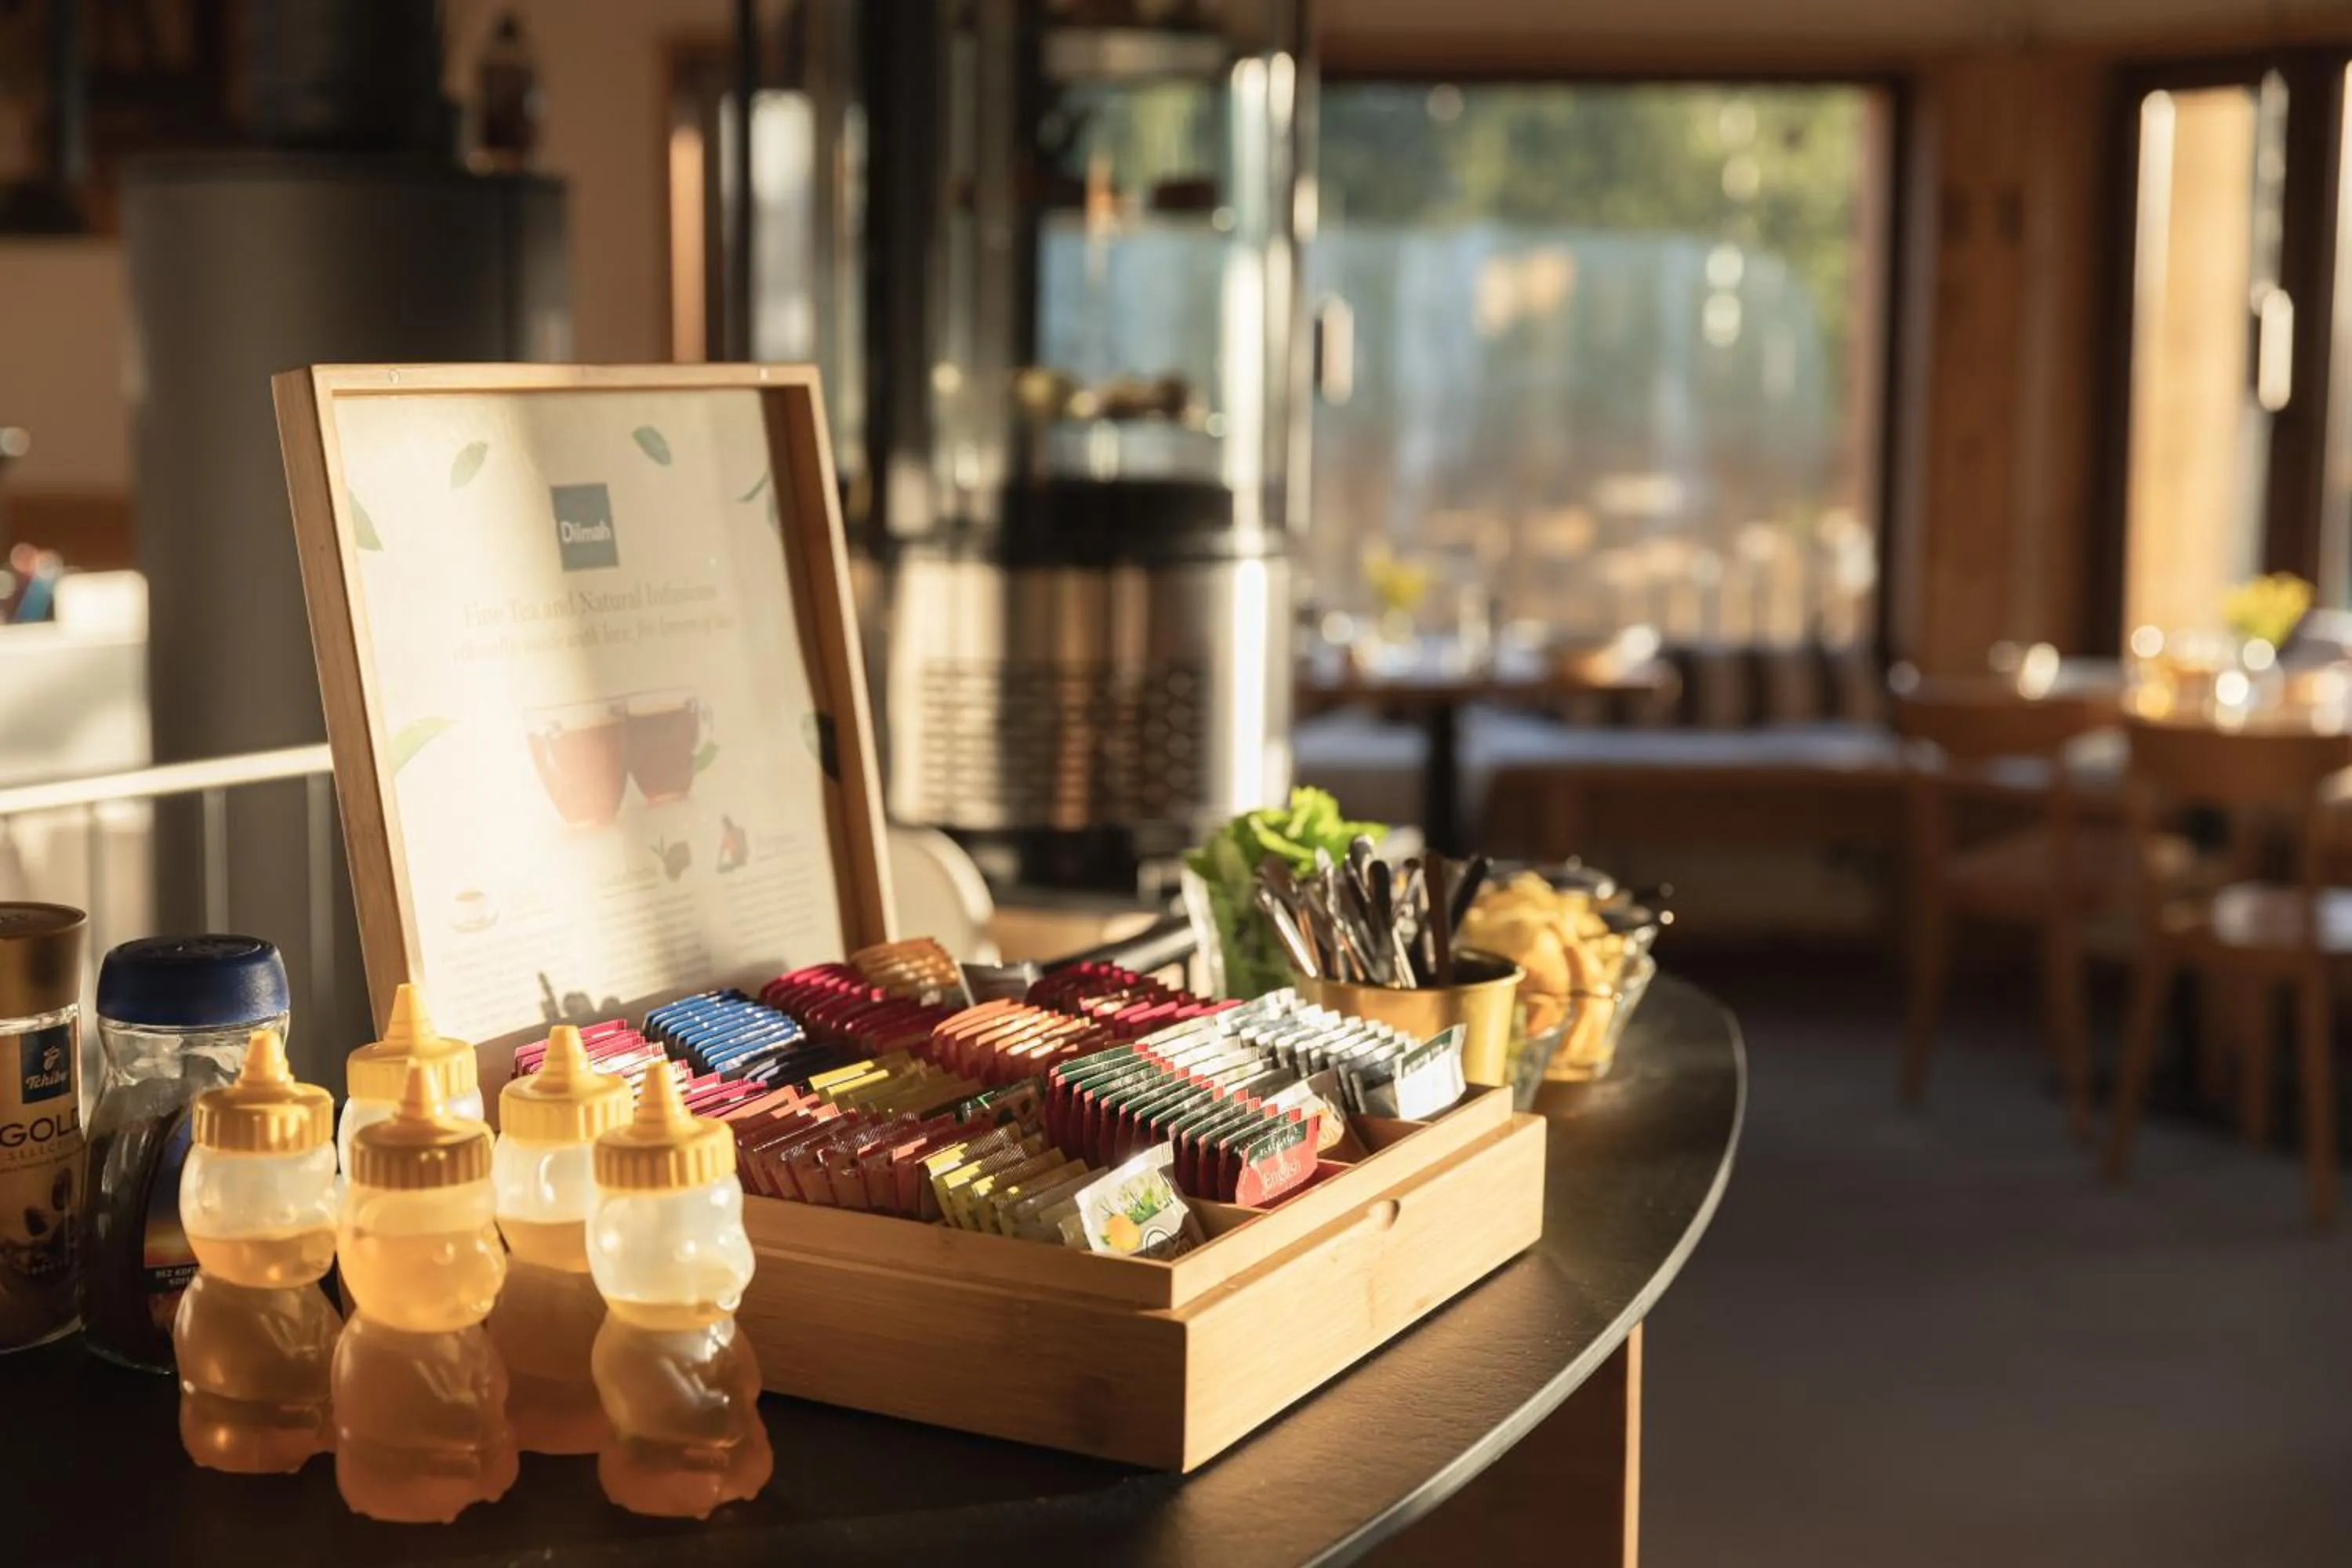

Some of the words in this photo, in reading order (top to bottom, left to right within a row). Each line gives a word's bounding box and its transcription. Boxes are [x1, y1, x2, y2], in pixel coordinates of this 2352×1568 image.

[560, 519, 611, 543] Dilmah
[462, 601, 502, 629] Fine
[504, 597, 539, 623] Tea
[543, 590, 577, 619] and
[578, 583, 641, 614] Natural
[25, 1069, 69, 1091] Tchibo
[0, 1106, 81, 1147] GOLD
